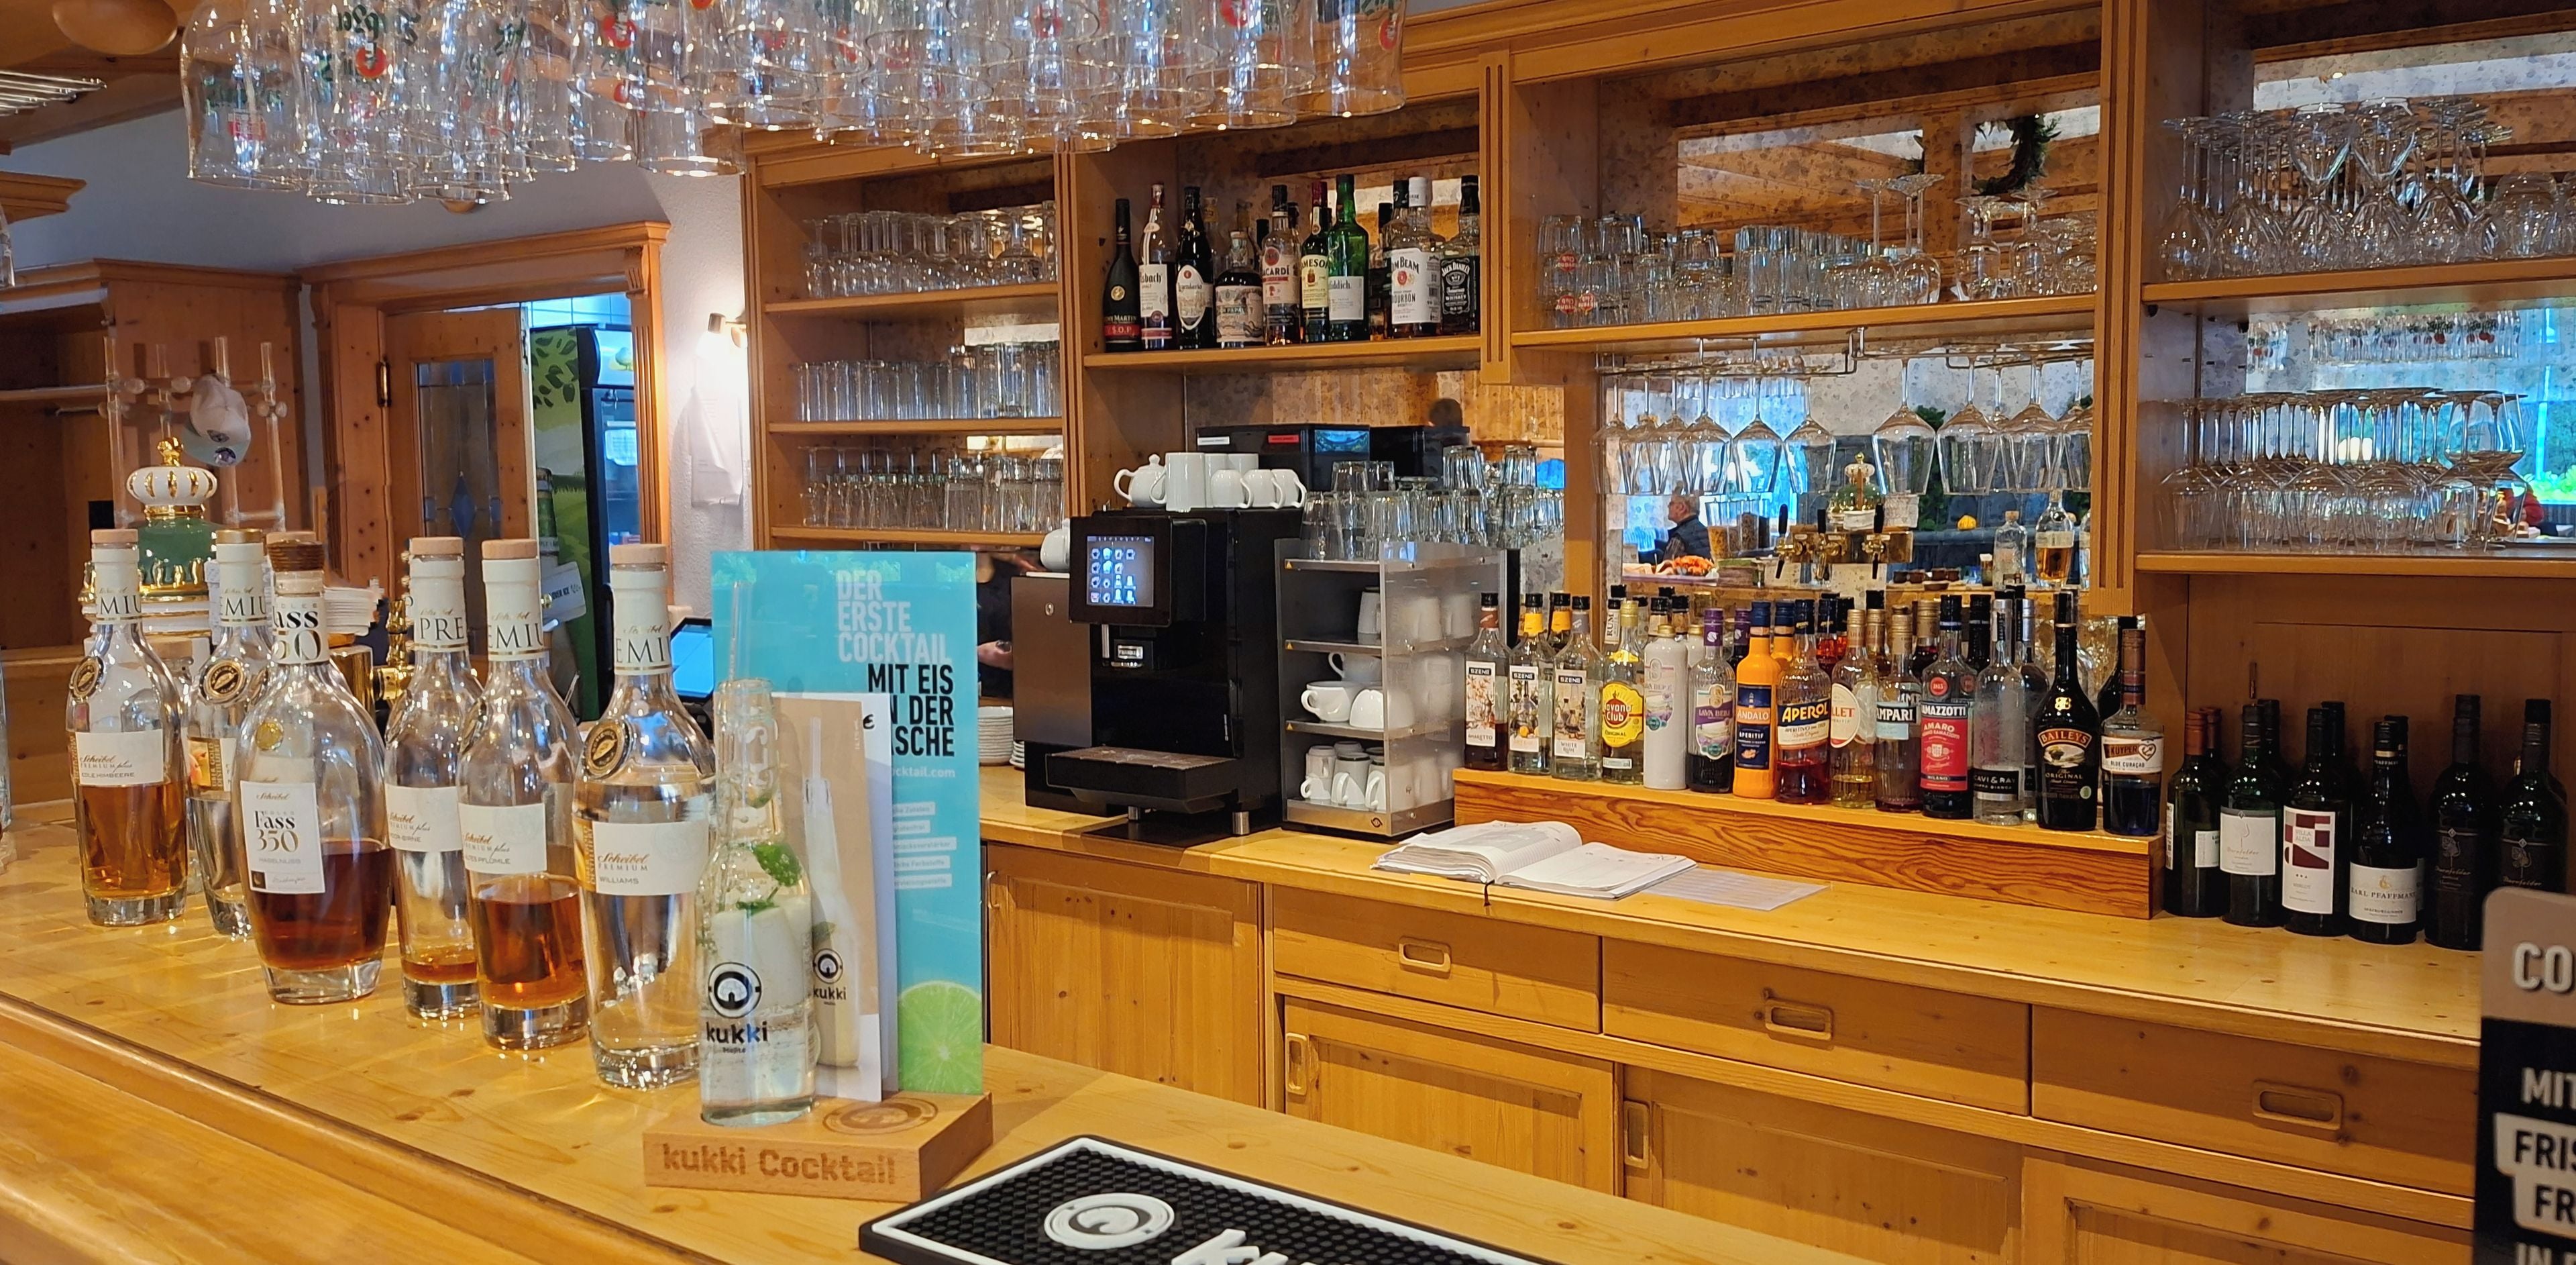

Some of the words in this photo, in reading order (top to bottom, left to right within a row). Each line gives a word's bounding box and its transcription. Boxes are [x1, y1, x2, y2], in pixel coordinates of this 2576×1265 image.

[1400, 256, 1419, 274] BEAM
[837, 570, 883, 601] DER
[839, 601, 911, 632] ERSTE
[1606, 613, 1614, 637] RUM
[420, 617, 464, 641] PRE
[839, 632, 953, 664] COCKTAIL
[868, 664, 909, 694] MIT
[918, 664, 954, 695] EIS
[909, 695, 954, 726] DER
[1606, 703, 1633, 713] avana
[1607, 711, 1624, 722] Club
[1782, 702, 1829, 723] APEROL
[1923, 722, 1955, 733] AMARO
[2041, 731, 2088, 744] BAILEYS
[891, 725, 955, 757] SCHE
[2110, 745, 2138, 756] KUYPER
[254, 810, 295, 830] Fass
[258, 828, 299, 852] 350
[597, 852, 649, 864] Scheibel
[598, 863, 649, 872] PREMIUM
[599, 875, 639, 884] WILLIAMS
[813, 986, 847, 1001] kukki
[706, 1021, 769, 1044] kukki
[661, 1143, 747, 1176] kukki
[758, 1148, 897, 1184] Cocktail
